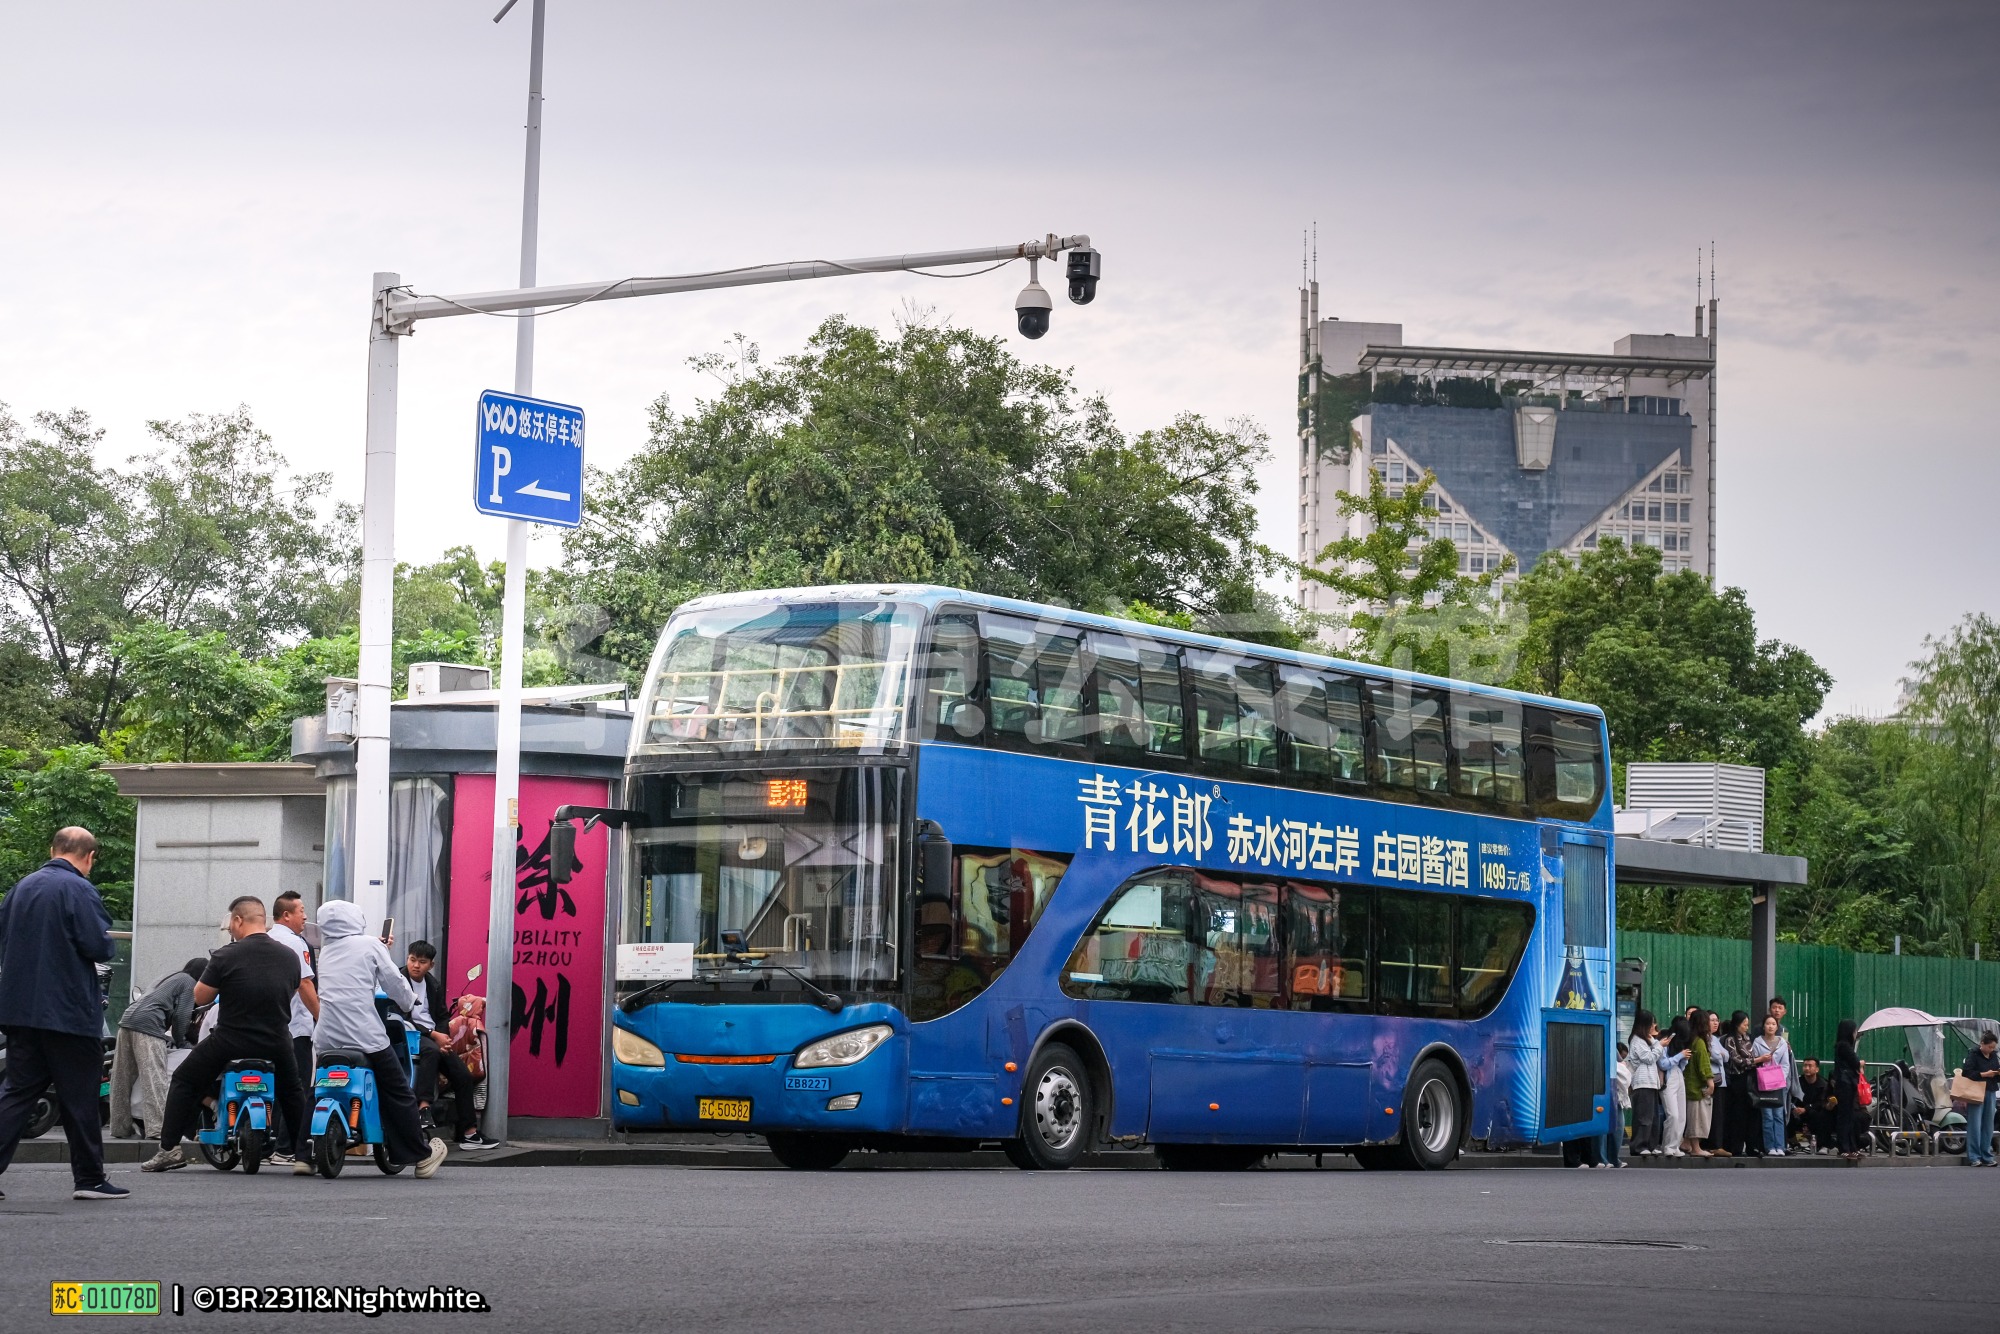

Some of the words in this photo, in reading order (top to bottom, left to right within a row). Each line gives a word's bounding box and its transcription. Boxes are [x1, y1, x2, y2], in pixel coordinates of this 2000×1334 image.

[518, 407, 582, 448] 悠沃停车场
[489, 445, 512, 504] P
[1227, 812, 1361, 876] 赤水河左岸
[1372, 830, 1469, 888] 庄园酱酒
[486, 930, 582, 948] BILITY
[513, 950, 572, 967] UZHOU
[787, 1079, 828, 1090] ZB8227
